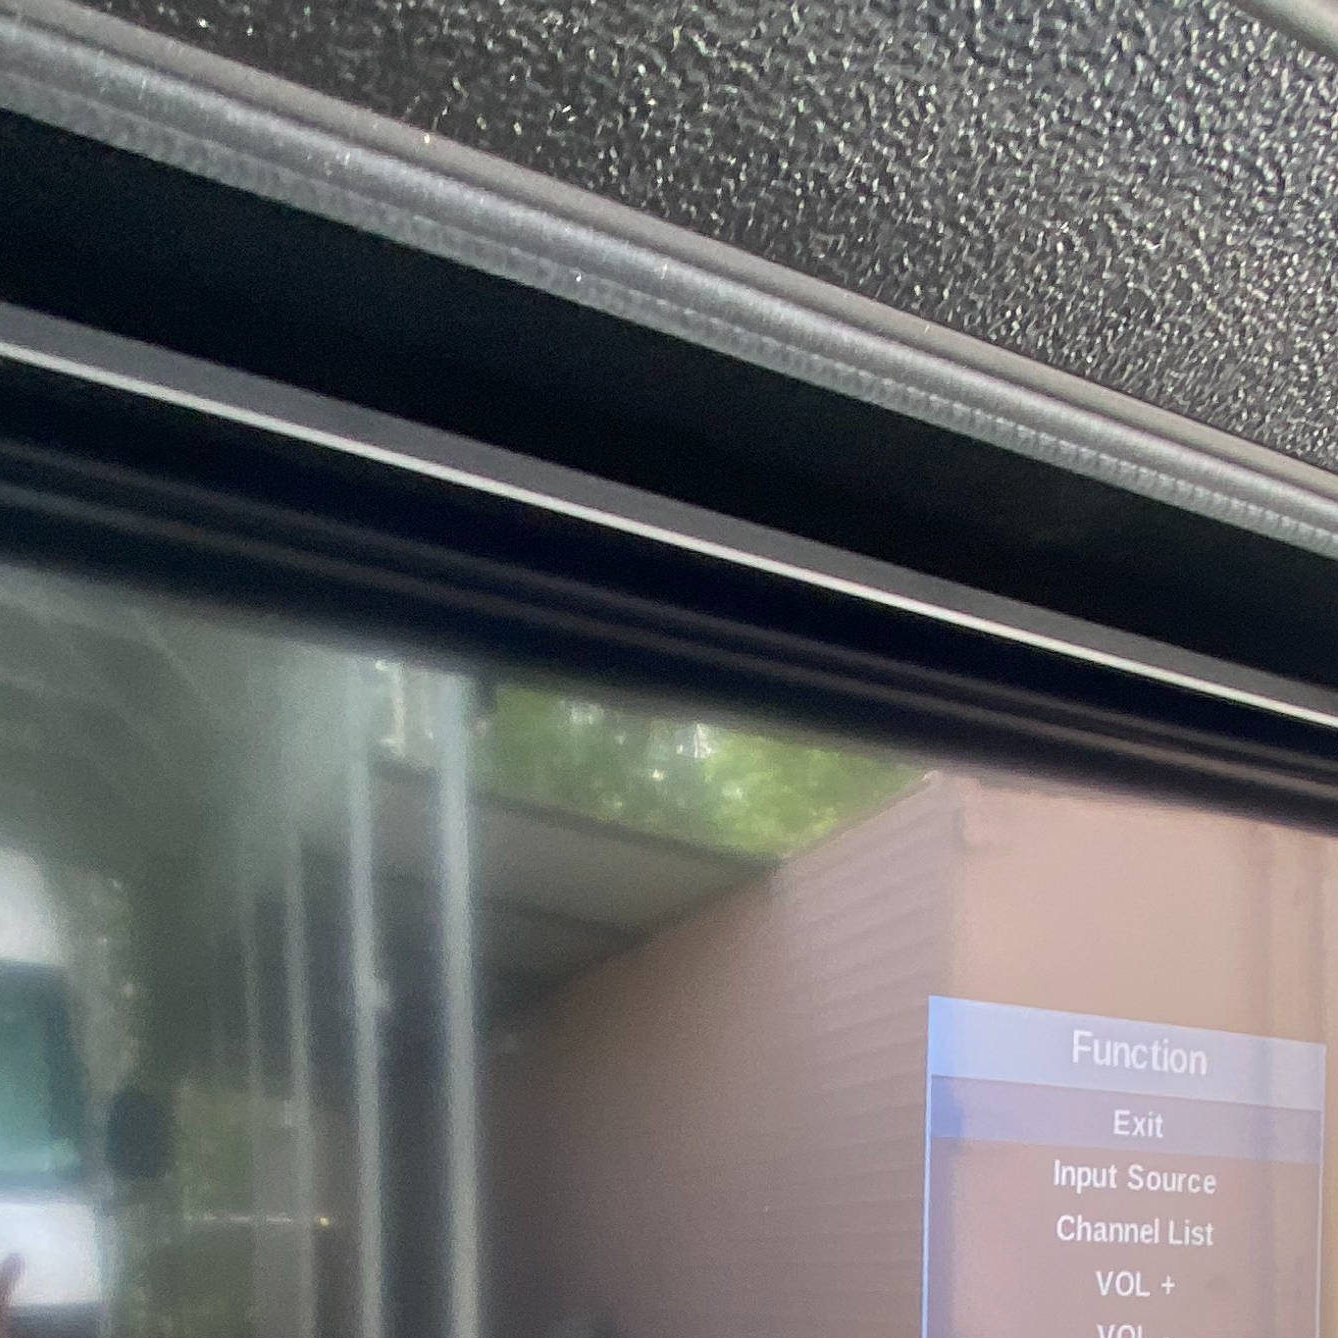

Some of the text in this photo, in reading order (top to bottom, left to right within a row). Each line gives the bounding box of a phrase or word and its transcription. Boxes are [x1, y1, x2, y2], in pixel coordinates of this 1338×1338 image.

[1072, 1028, 1208, 1076] Function
[1113, 1108, 1164, 1139] Exit
[1053, 1159, 1217, 1195] Input Source
[1056, 1214, 1215, 1247] Channel List
[1095, 1270, 1176, 1298] VOL +
